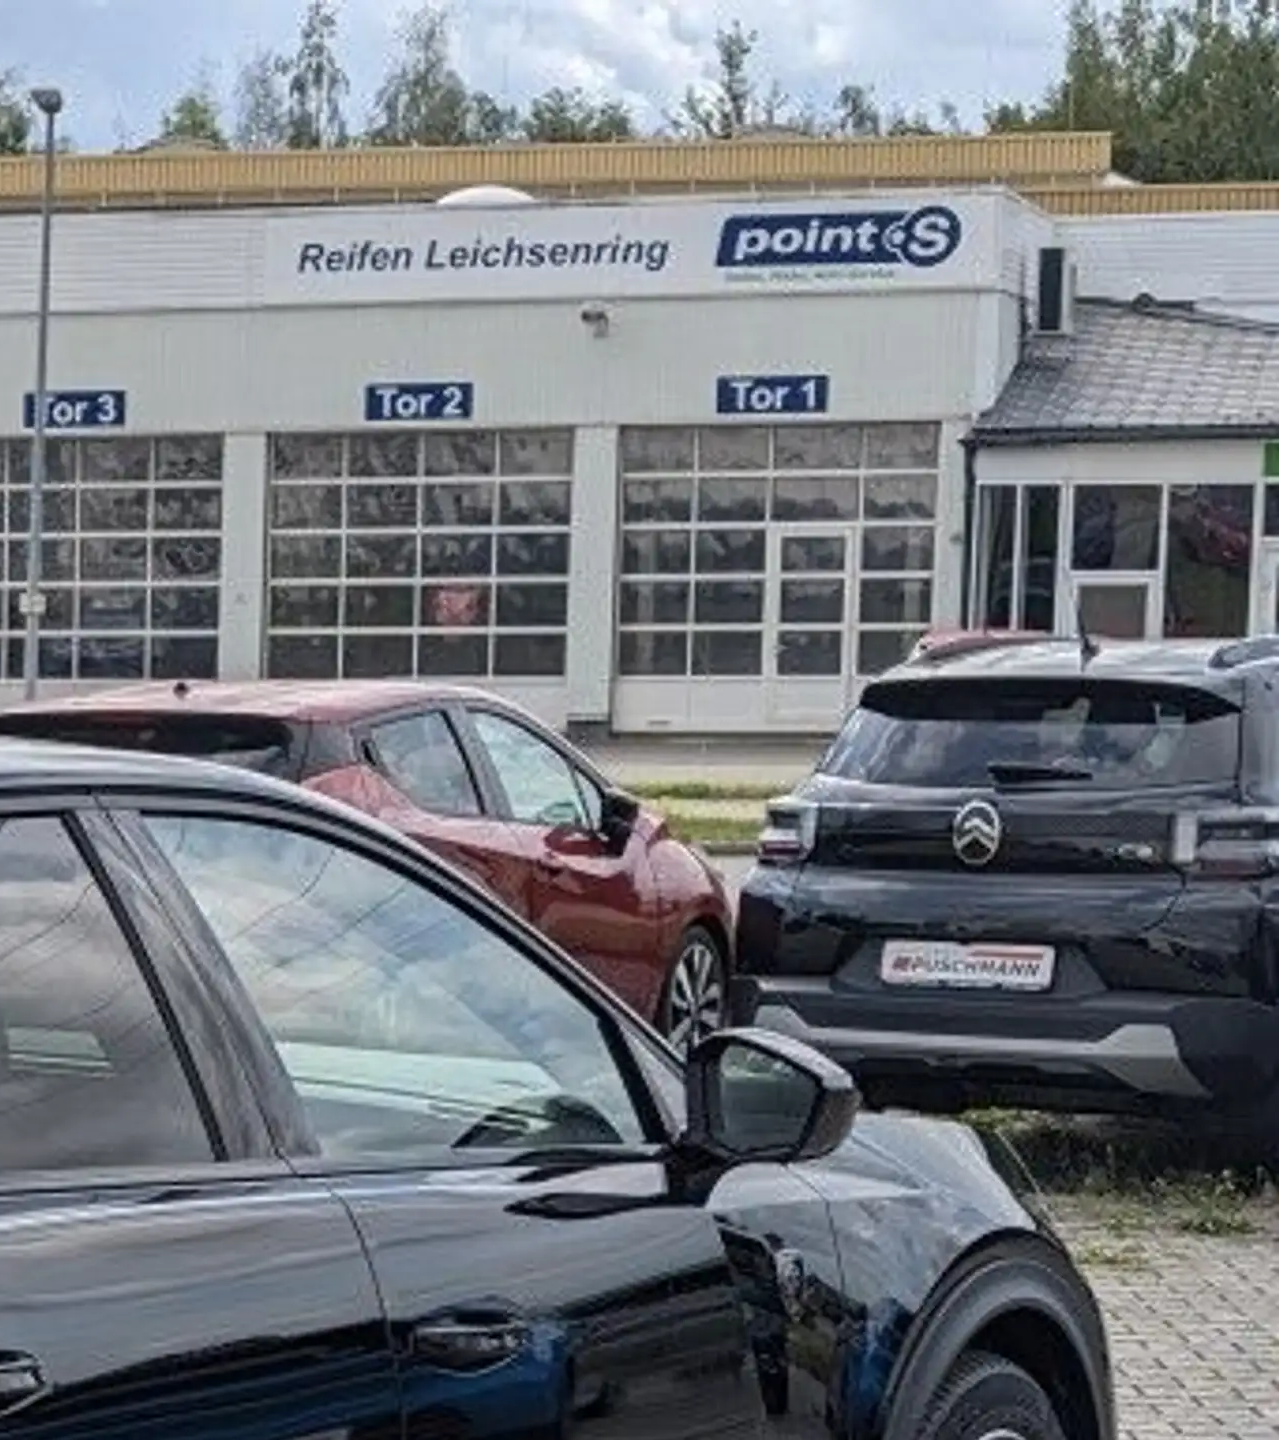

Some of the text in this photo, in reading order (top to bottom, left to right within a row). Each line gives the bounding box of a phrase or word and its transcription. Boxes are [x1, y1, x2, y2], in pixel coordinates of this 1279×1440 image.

[298, 234, 671, 273] Reifen Leichsenring
[733, 217, 879, 261] point
[96, 393, 118, 422] 3
[375, 385, 464, 418] Tor 2
[729, 379, 817, 411] Tor 1
[911, 955, 1041, 977] PUSCHMANN
